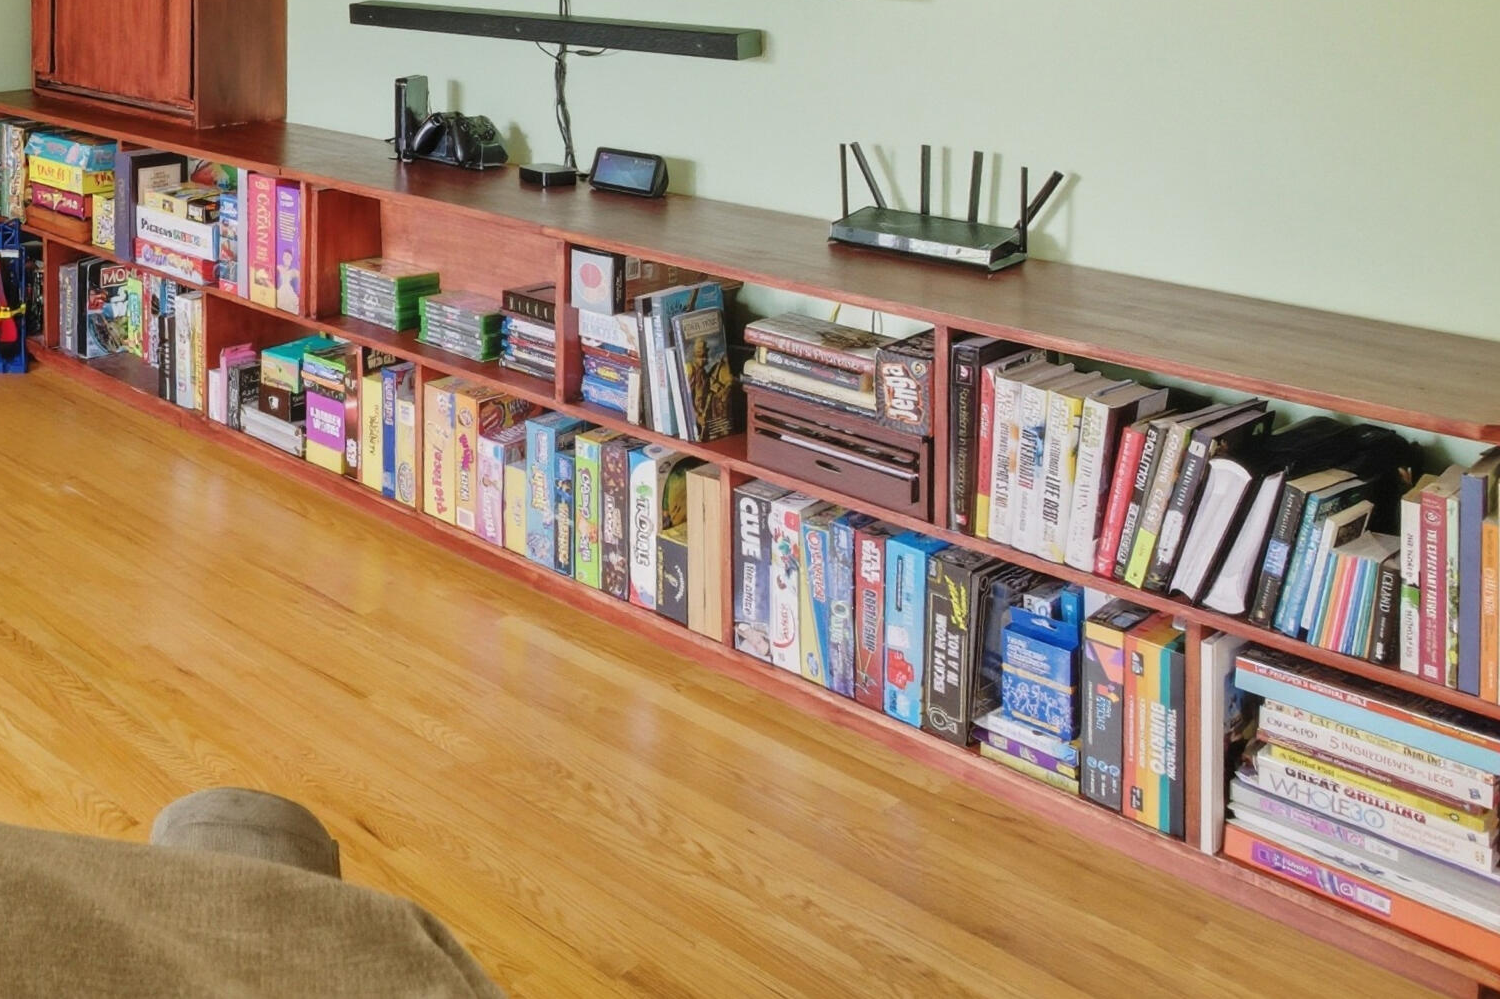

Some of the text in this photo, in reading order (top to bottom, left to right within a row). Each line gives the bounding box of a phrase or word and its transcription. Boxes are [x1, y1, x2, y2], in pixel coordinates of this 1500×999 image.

[884, 364, 918, 422] Jenga
[1017, 428, 1037, 493] AFTERMATH
[1135, 426, 1158, 491] EVOLUTION
[739, 495, 761, 561] CLUE
[1377, 570, 1394, 613] ICELAND
[946, 630, 959, 658] BOX
[1149, 700, 1165, 776] BURRITO
[1165, 706, 1176, 781] THROW THROW
[1269, 772, 1384, 831] WHOLE30
[1285, 766, 1425, 825] GREAT GRILLING
